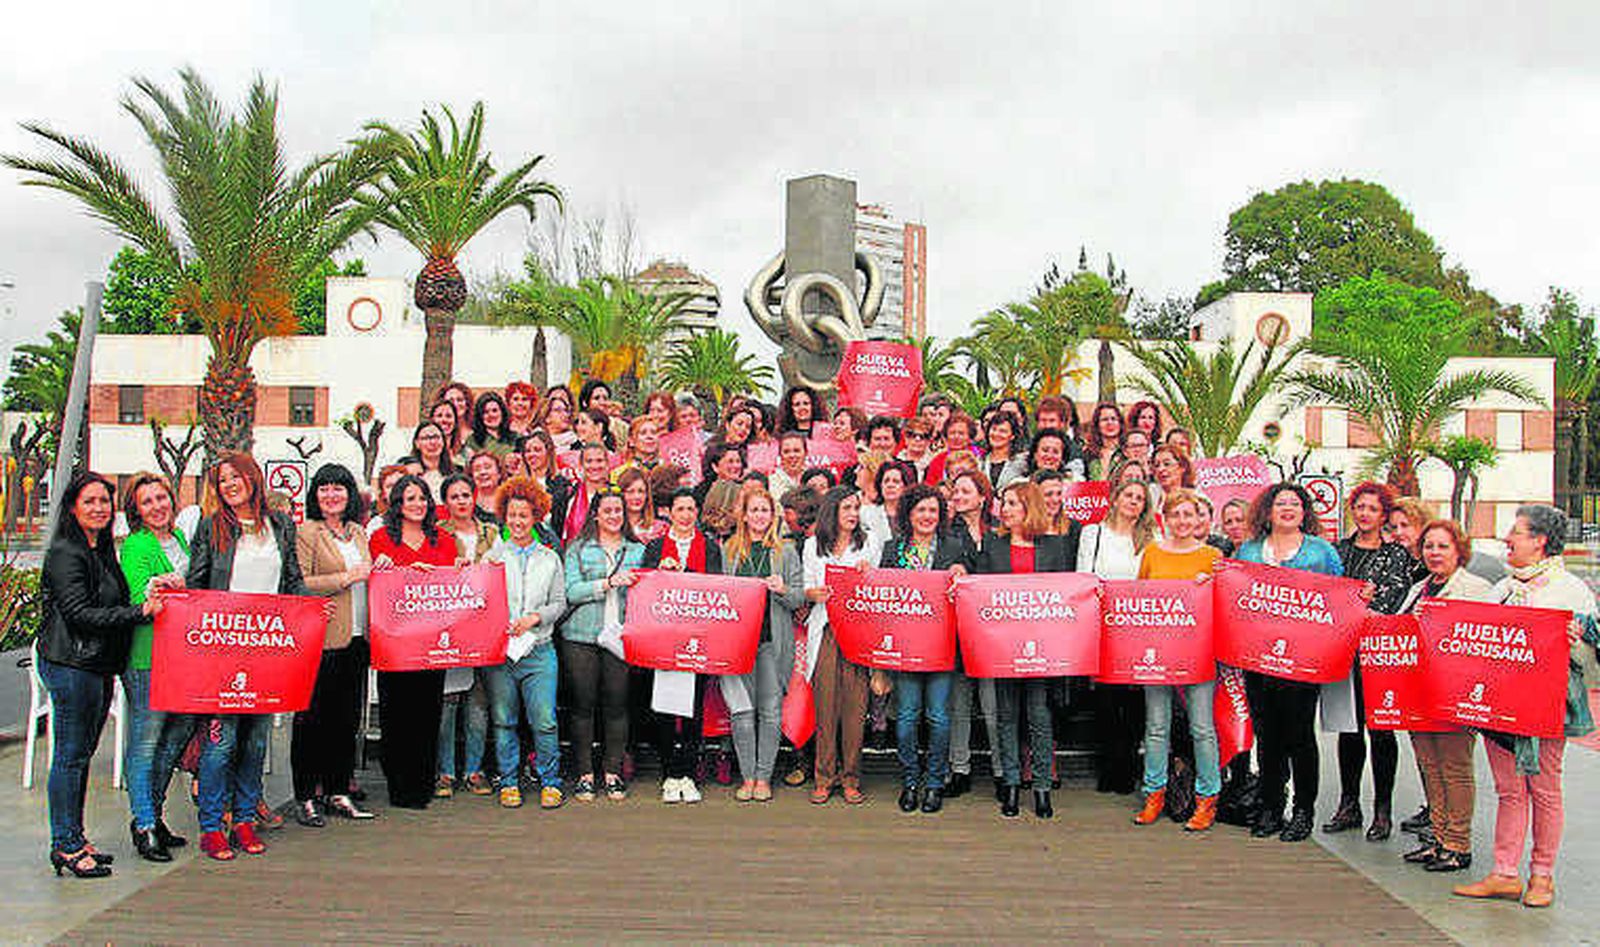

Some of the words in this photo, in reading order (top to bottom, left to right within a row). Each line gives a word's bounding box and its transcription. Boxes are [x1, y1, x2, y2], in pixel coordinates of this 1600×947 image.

[405, 584, 474, 599] HUELVA
[662, 588, 730, 607] HUELVA
[855, 585, 923, 602] HUELVA
[992, 591, 1062, 607] HUELVA
[1251, 582, 1325, 609] HUELVA
[651, 602, 739, 621] CONSUSANA
[845, 599, 933, 615] CONSUSANA
[980, 606, 1074, 620] CONSUSANA
[1115, 598, 1186, 613] HUELVA
[1238, 595, 1334, 625] CONSUSANA
[202, 612, 285, 632] HUELVA
[1105, 613, 1197, 626] CONSUSANA
[186, 630, 296, 647] CONSUSANA
[1360, 635, 1418, 651] HUELVA
[1452, 622, 1527, 647] HUELVA
[1438, 638, 1536, 663] CONSUSANA
